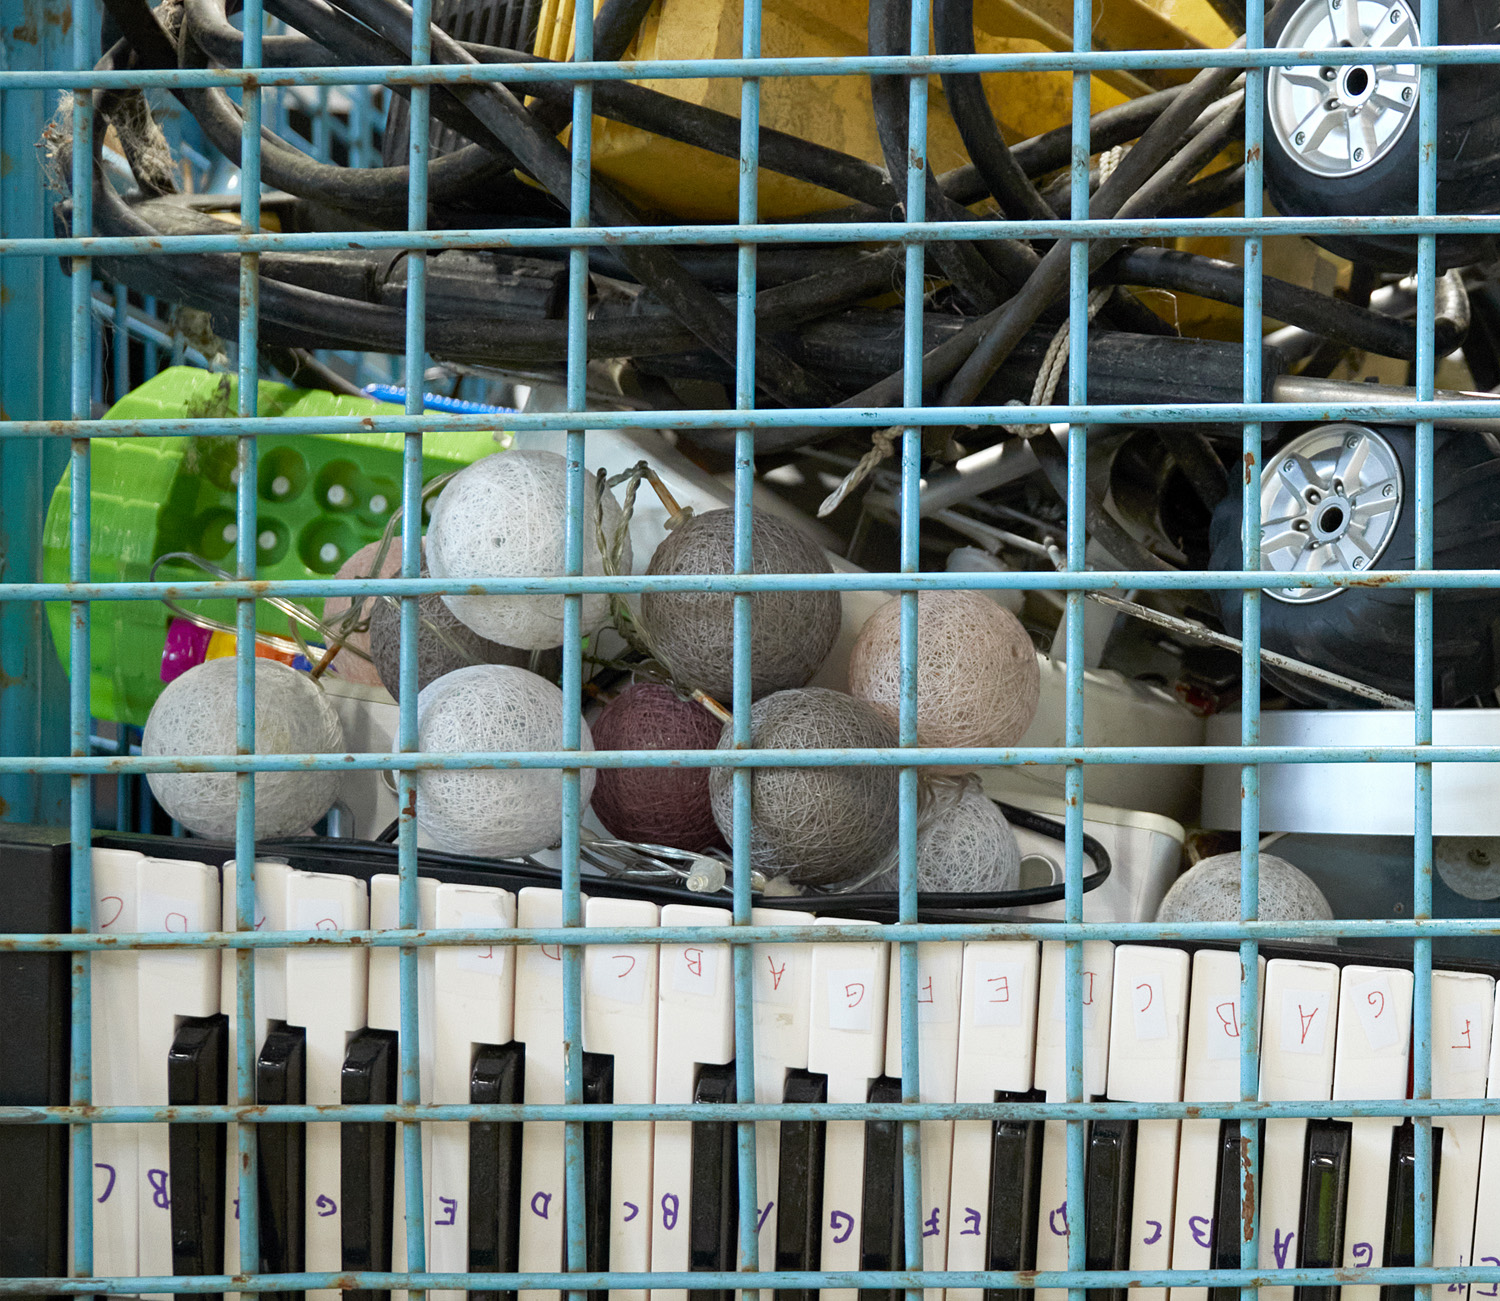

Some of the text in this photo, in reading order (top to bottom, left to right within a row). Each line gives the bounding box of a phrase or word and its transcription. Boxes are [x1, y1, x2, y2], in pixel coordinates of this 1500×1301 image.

[101, 896, 124, 929] C
[612, 955, 636, 978] C
[684, 947, 703, 977] B
[767, 955, 786, 991] A
[845, 982, 865, 1008] G
[986, 975, 1009, 1003] E
[1136, 983, 1153, 1013] C
[1216, 1001, 1240, 1038] B
[1298, 1004, 1319, 1045] A
[1367, 990, 1385, 1019] G
[1451, 1018, 1472, 1049] F
[94, 1163, 117, 1203] C
[434, 1196, 459, 1226] E
[530, 1191, 553, 1219] D
[829, 1210, 855, 1244] G
[959, 1207, 982, 1236] E
[1273, 1227, 1295, 1270] A
